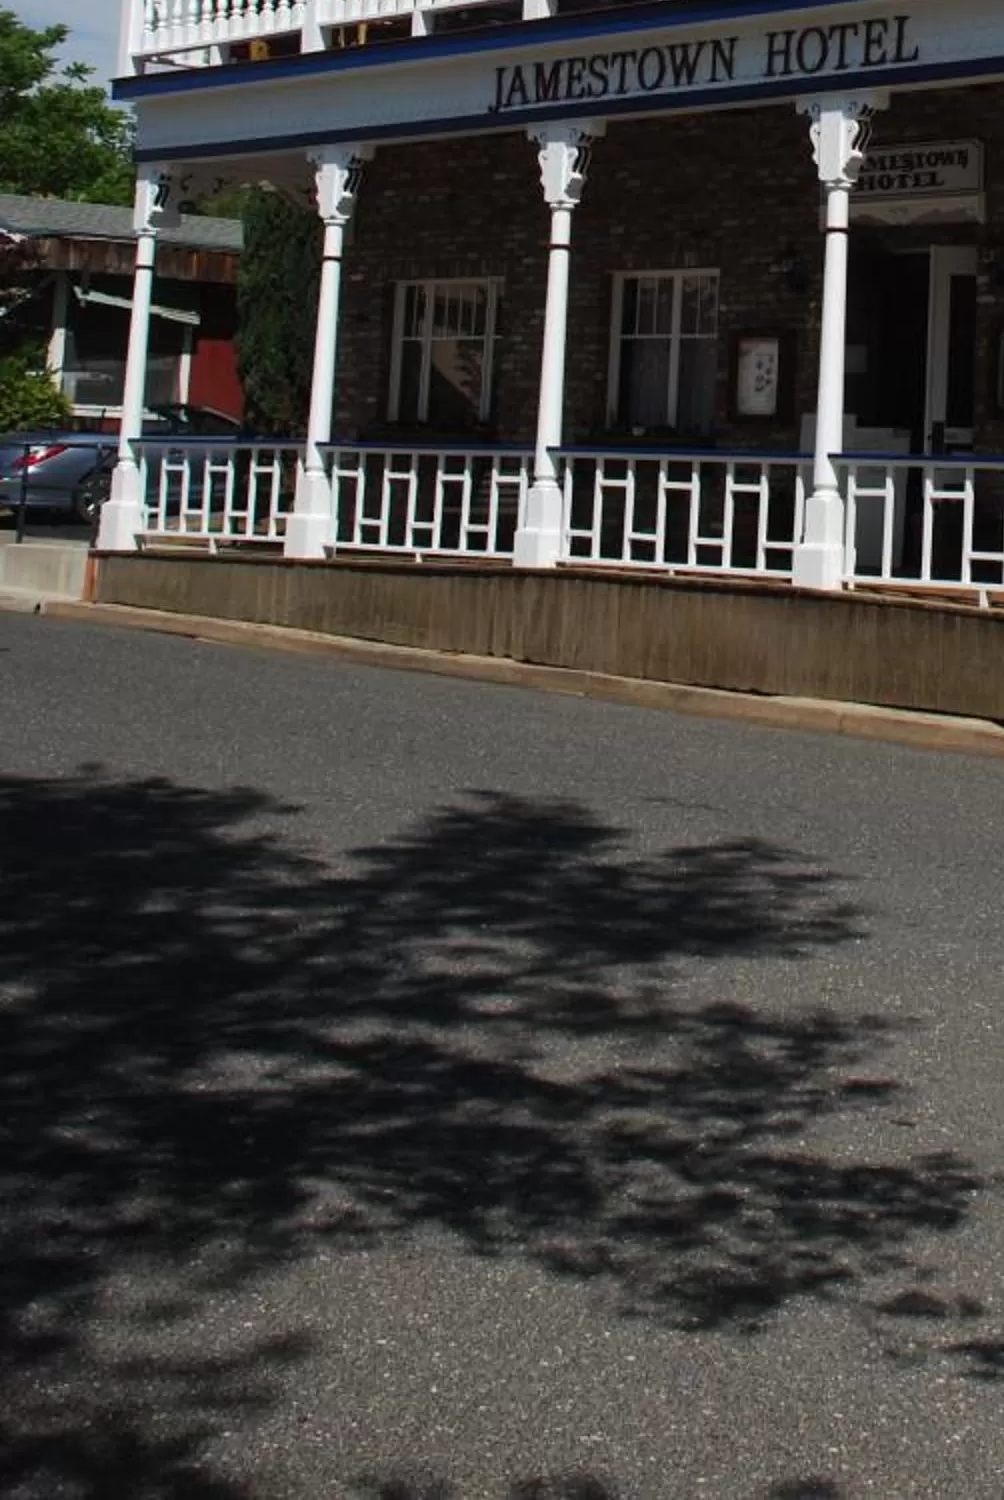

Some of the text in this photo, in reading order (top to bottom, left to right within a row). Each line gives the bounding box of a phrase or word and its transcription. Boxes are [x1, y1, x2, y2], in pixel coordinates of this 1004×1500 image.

[489, 15, 919, 113] JAMESTOWN HOTEL
[859, 148, 969, 172] MESTOWN
[854, 171, 945, 192] HOTEL
